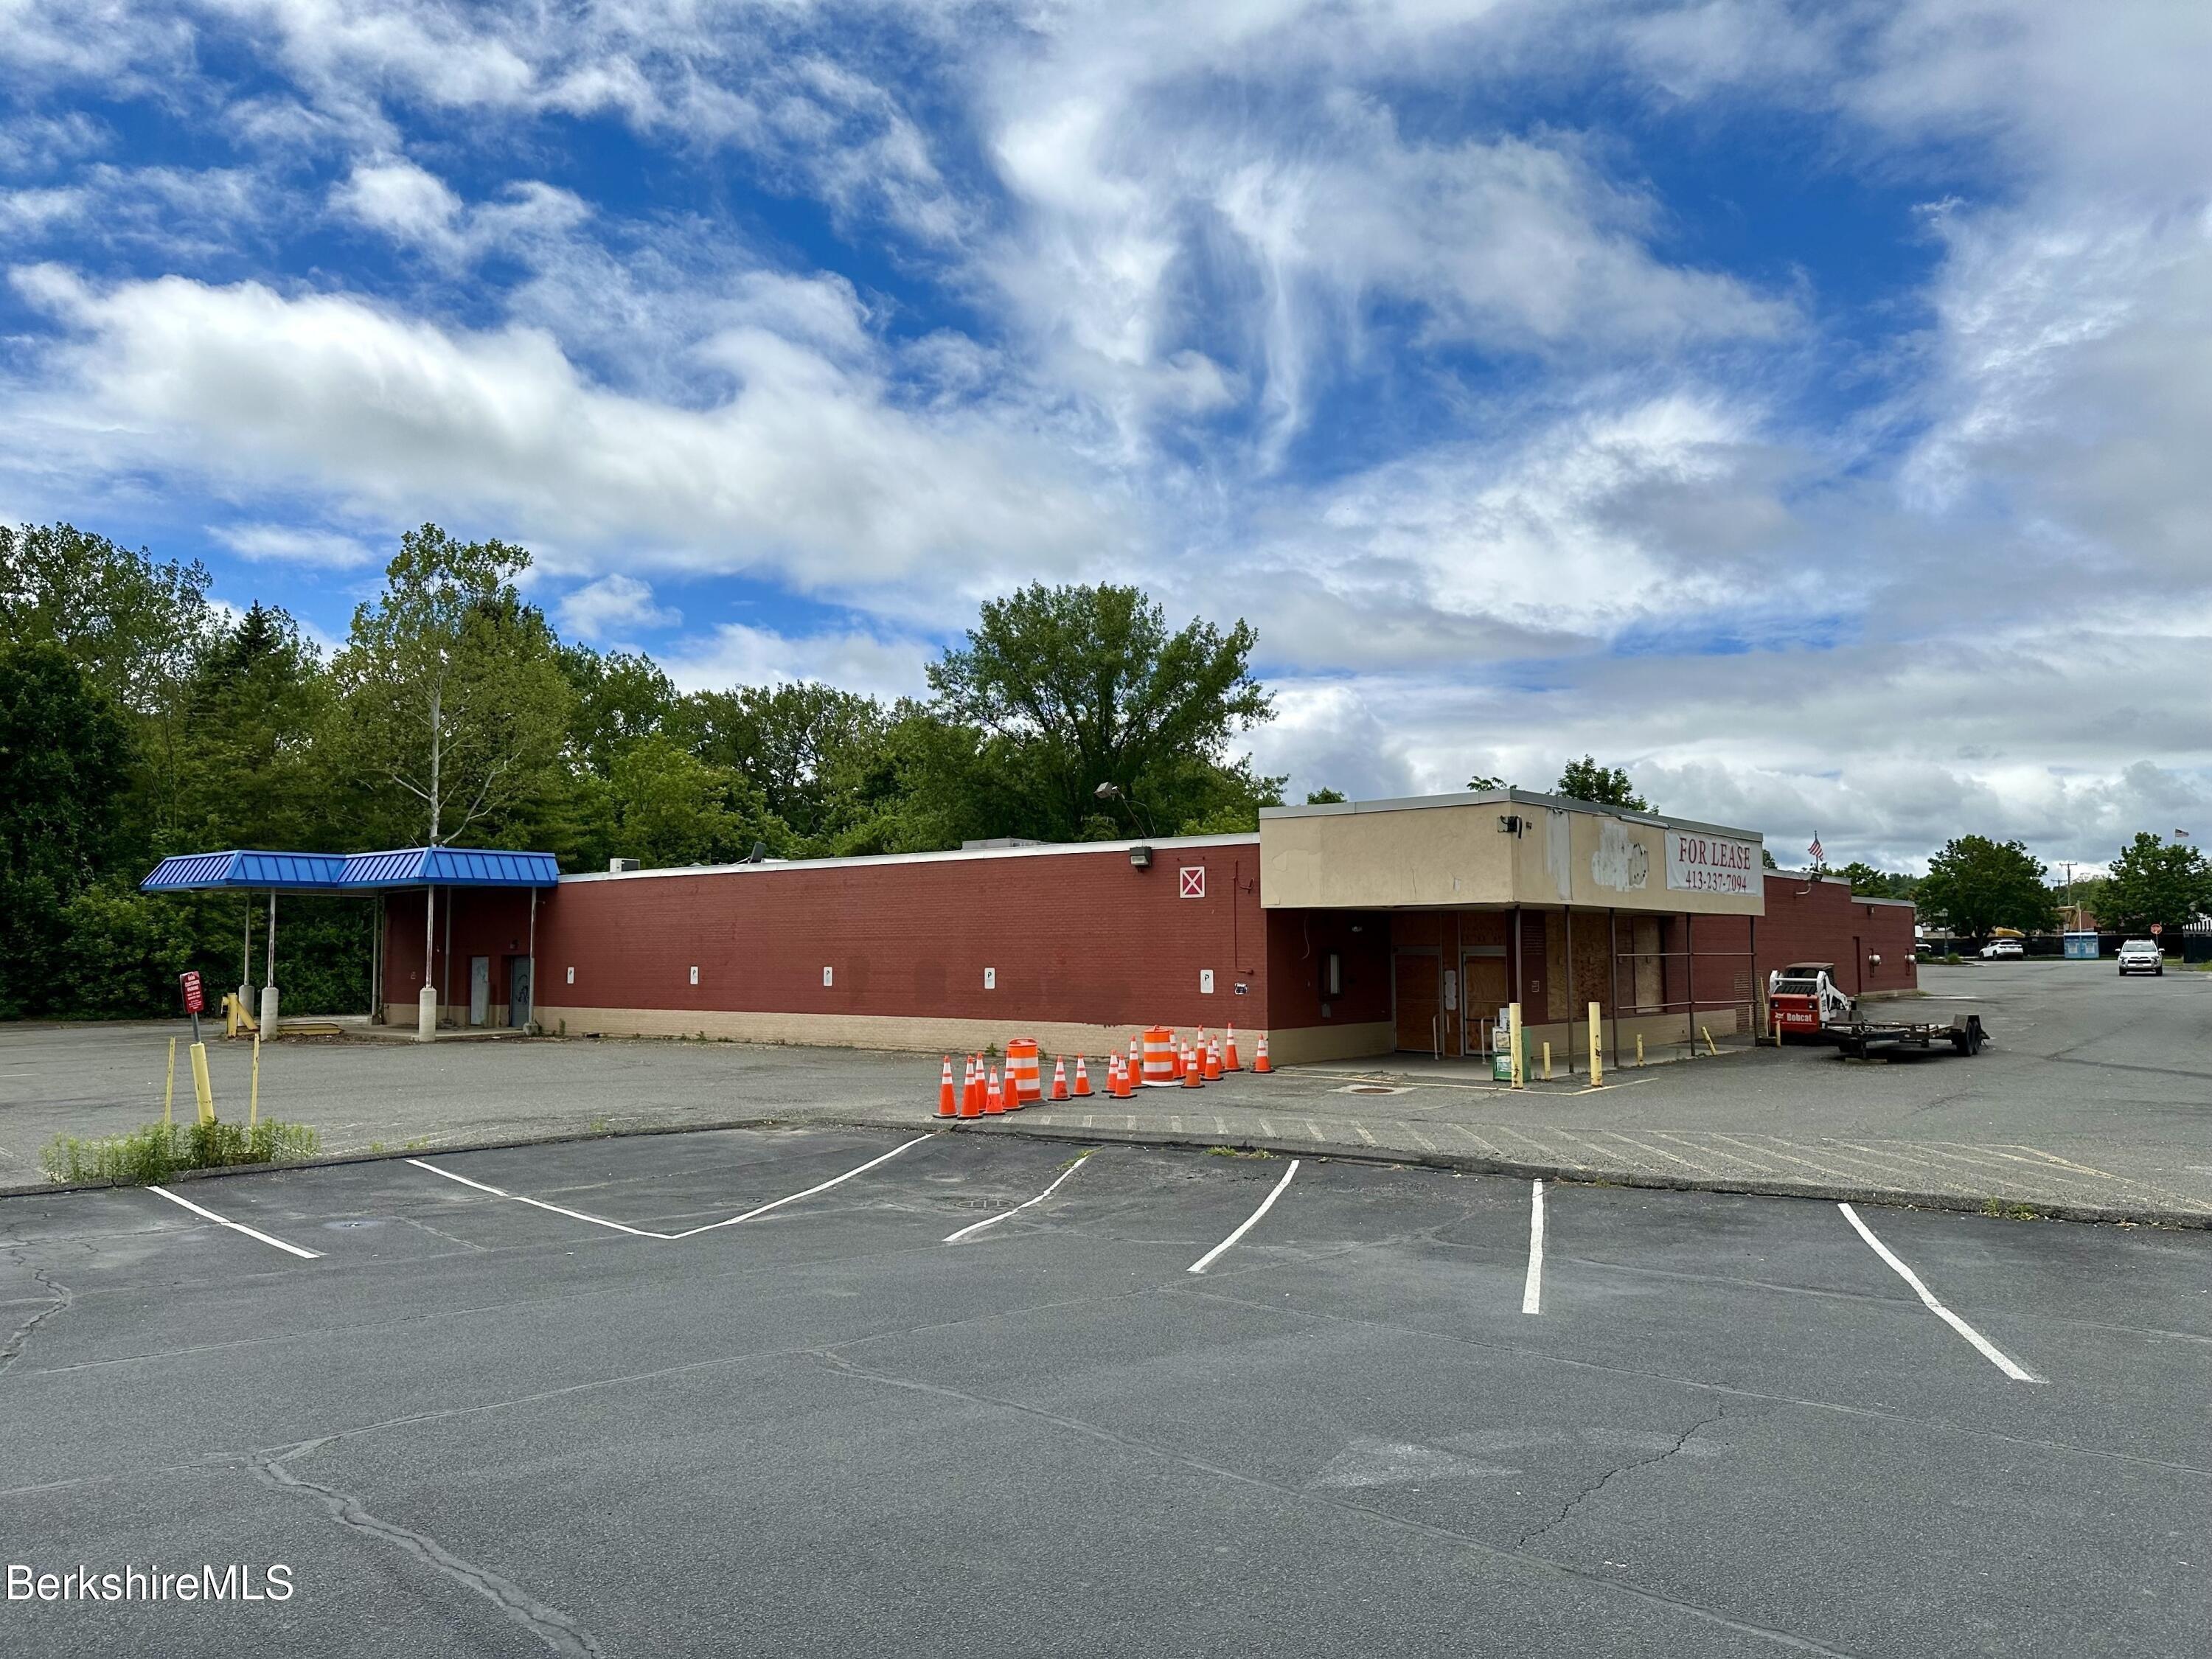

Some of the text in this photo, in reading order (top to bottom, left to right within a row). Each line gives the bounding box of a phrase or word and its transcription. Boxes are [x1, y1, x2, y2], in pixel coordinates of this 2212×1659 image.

[1679, 837, 1750, 870] FOR LEASE
[1686, 869, 1747, 894] 413-237-7094
[1787, 1013, 1812, 1022] Bobcat
